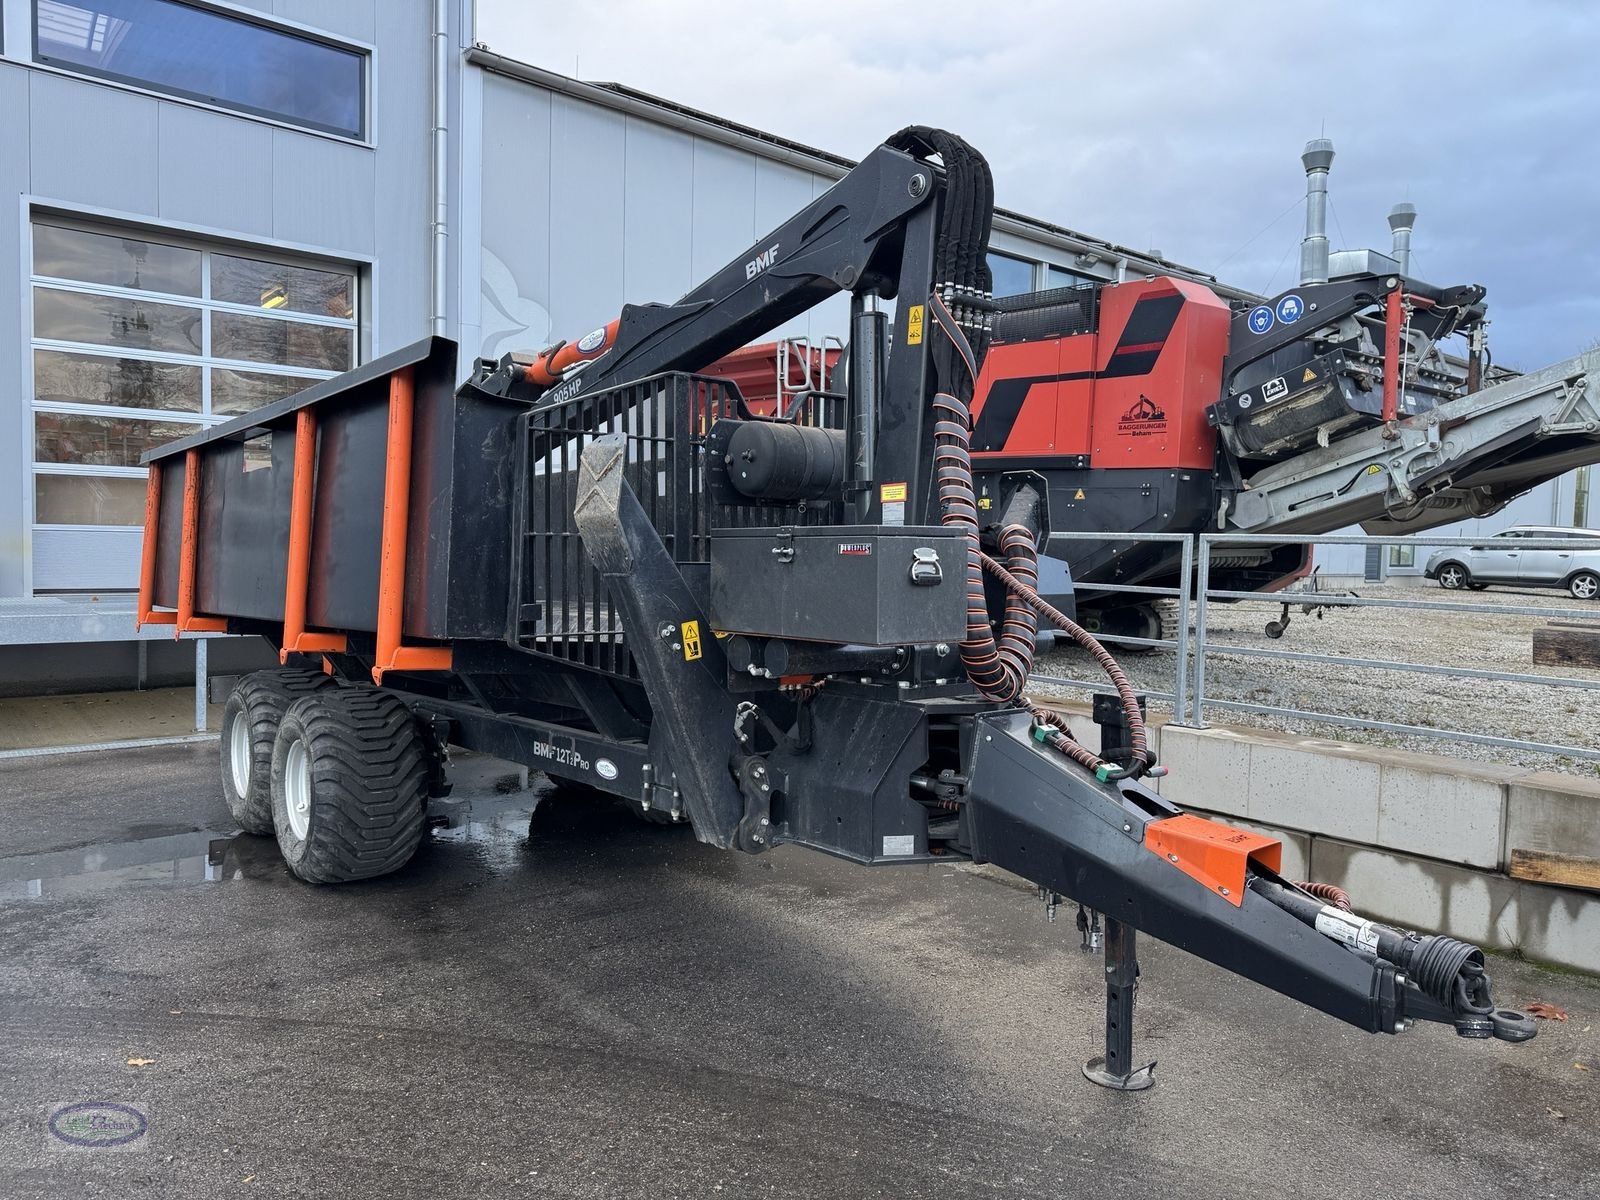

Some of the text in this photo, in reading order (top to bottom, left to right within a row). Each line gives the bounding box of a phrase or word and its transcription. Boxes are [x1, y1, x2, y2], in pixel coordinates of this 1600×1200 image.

[745, 243, 780, 280] BMF
[1118, 422, 1167, 431] BAGGERUNGEN
[533, 741, 556, 759] BMF
